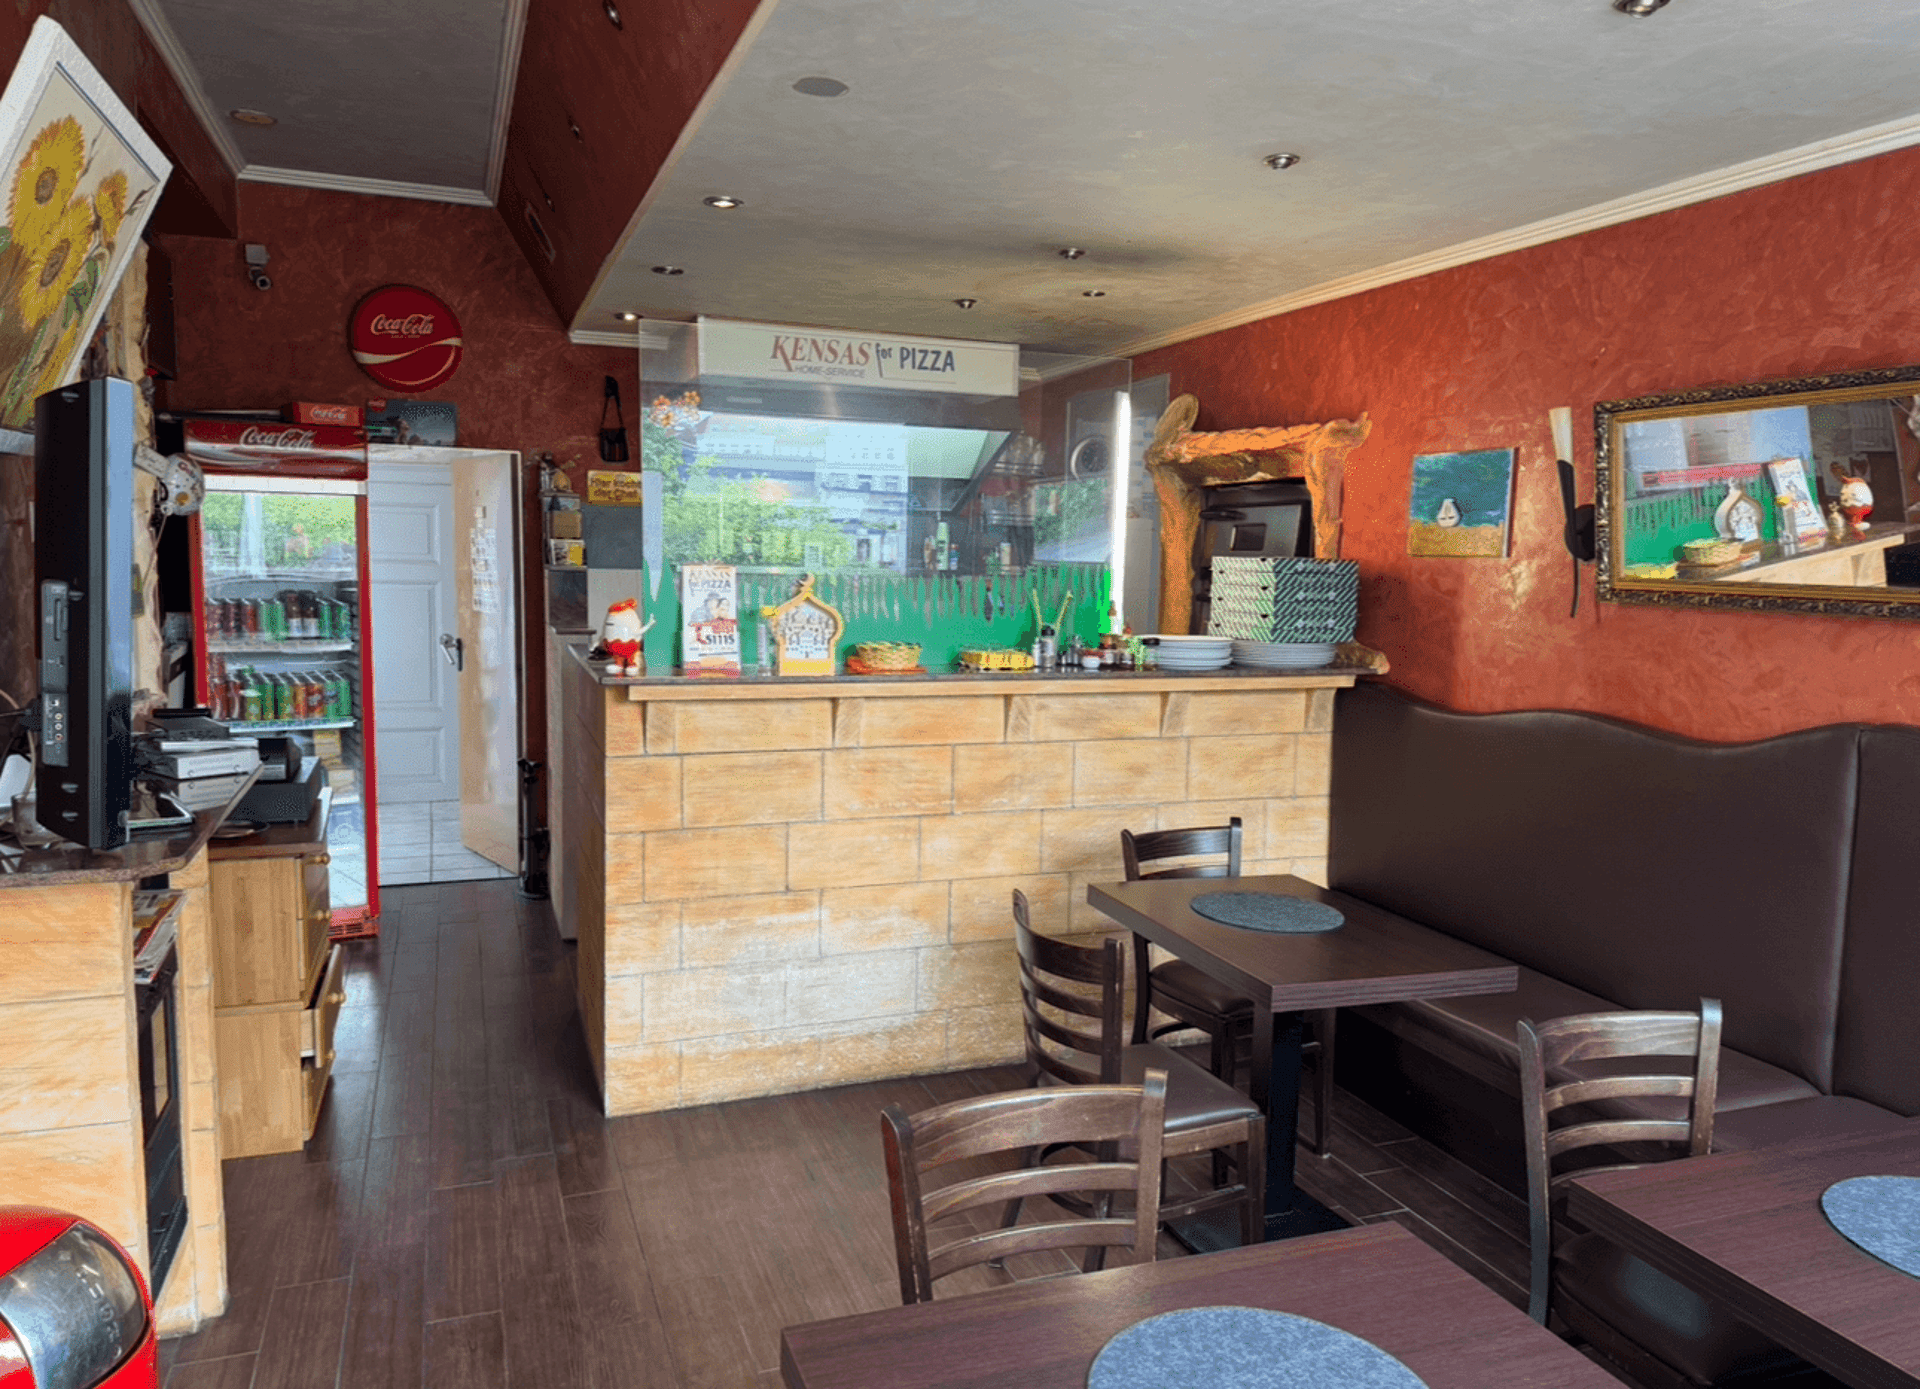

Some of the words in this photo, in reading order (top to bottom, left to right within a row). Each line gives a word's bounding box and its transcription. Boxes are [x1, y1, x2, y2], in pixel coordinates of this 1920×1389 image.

[370, 313, 435, 335] Coca-Cola
[770, 335, 872, 372] KENSAS
[874, 342, 893, 378] for
[900, 346, 955, 372] PIZZA
[239, 426, 317, 450] Coca-Cola
